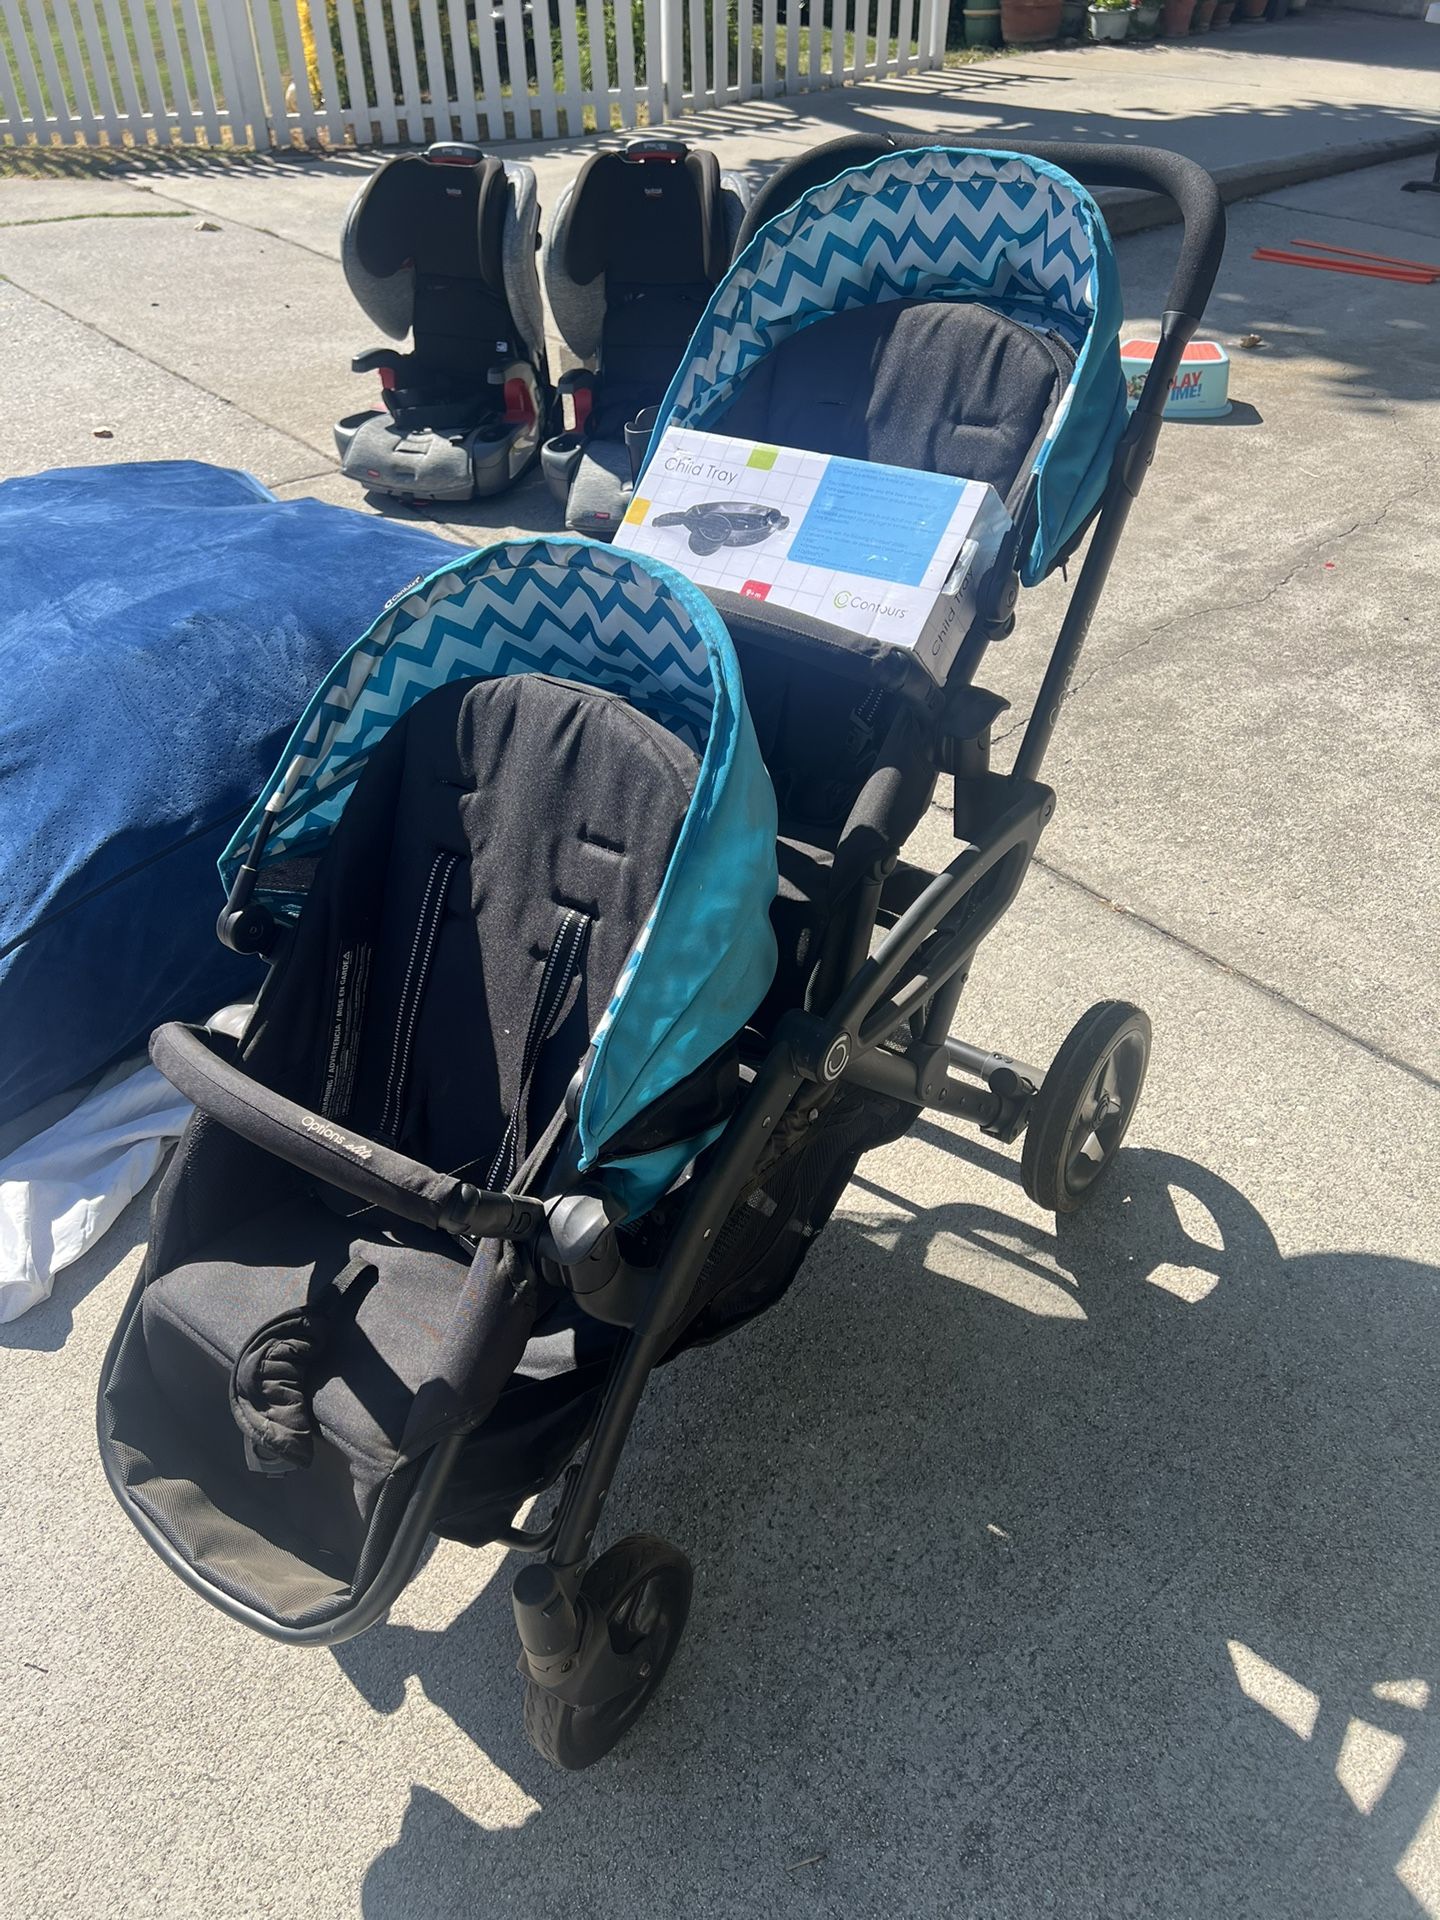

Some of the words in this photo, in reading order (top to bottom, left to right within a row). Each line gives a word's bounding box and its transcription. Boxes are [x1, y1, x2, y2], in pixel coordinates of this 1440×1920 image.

[664, 457, 704, 476] Child
[706, 464, 738, 486] Tray
[850, 596, 908, 619] Contours
[931, 607, 956, 656] Child
[954, 565, 973, 604] Tray
[301, 1116, 346, 1145] Options
